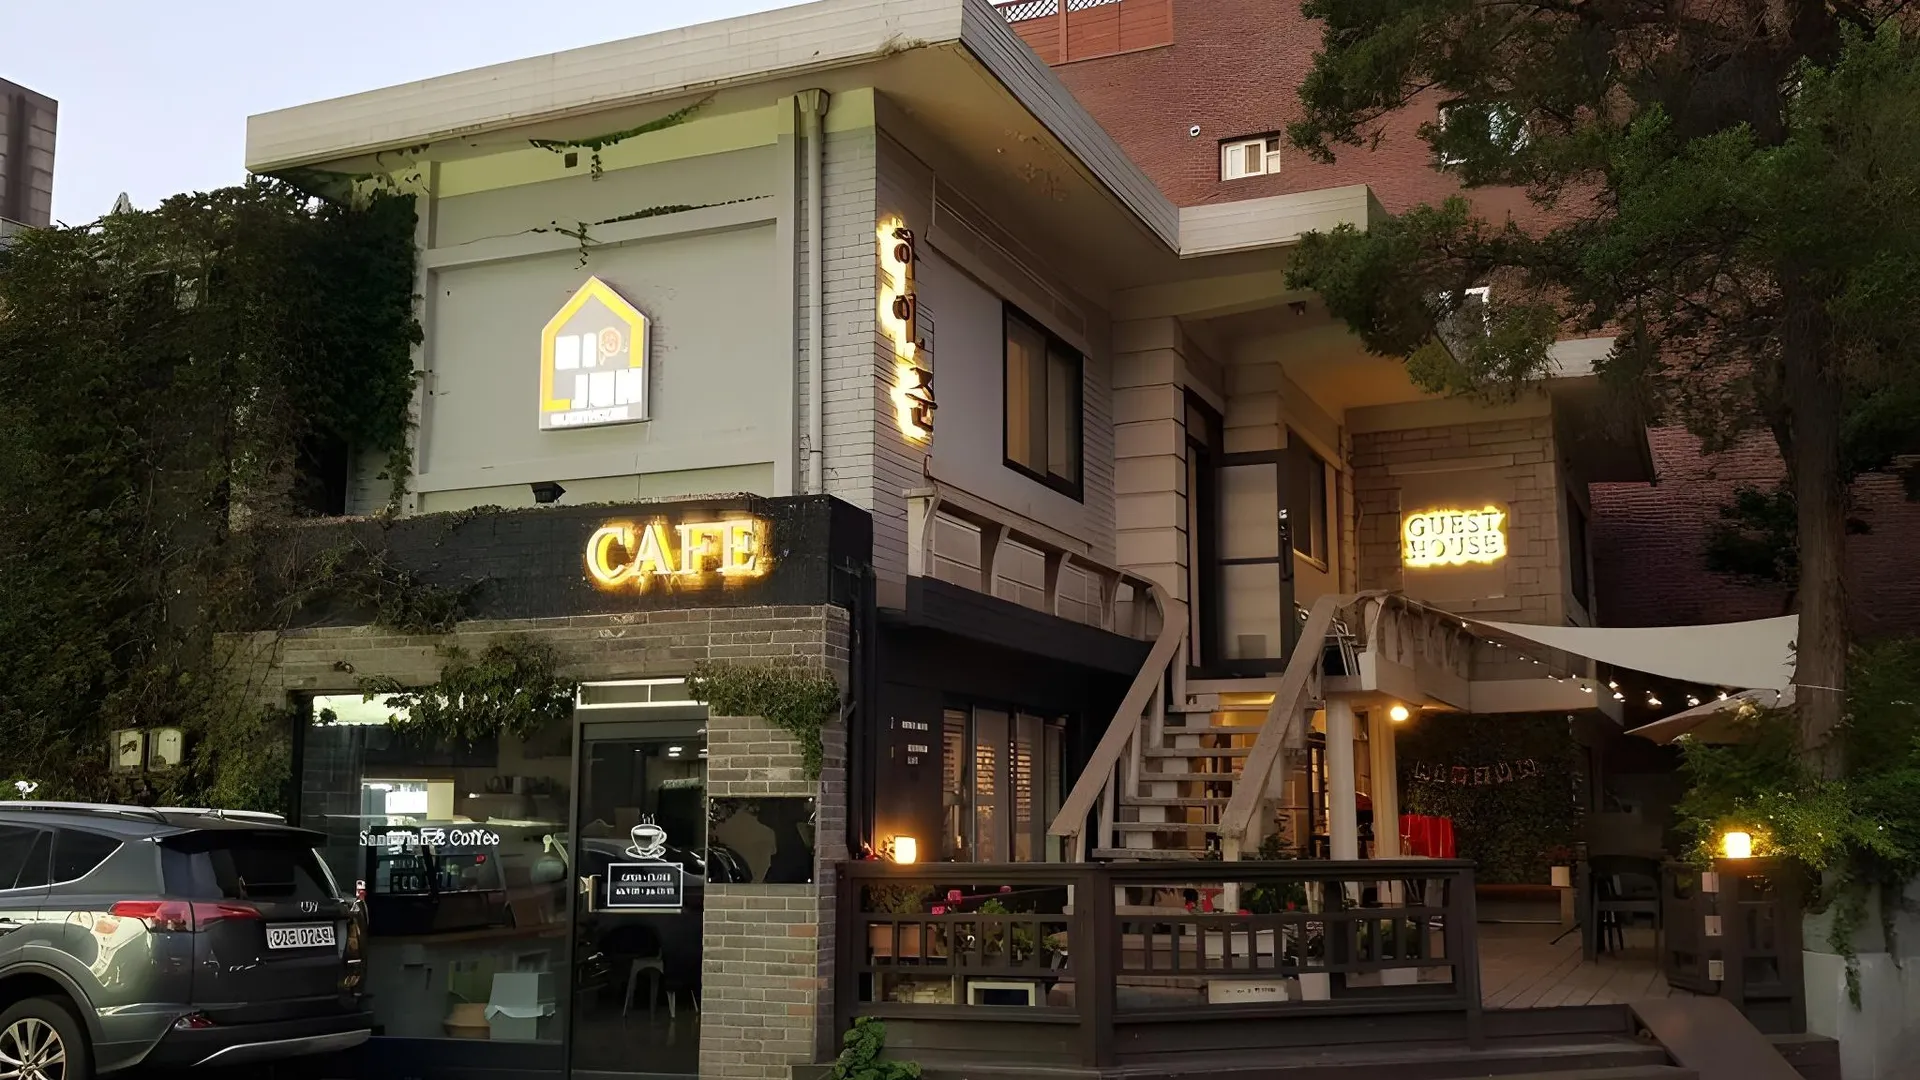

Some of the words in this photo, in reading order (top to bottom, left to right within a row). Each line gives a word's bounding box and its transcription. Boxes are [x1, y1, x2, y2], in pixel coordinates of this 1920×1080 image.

[1408, 511, 1499, 537] GUEST
[586, 519, 757, 581] CAFE
[1408, 534, 1499, 559] HOUSE
